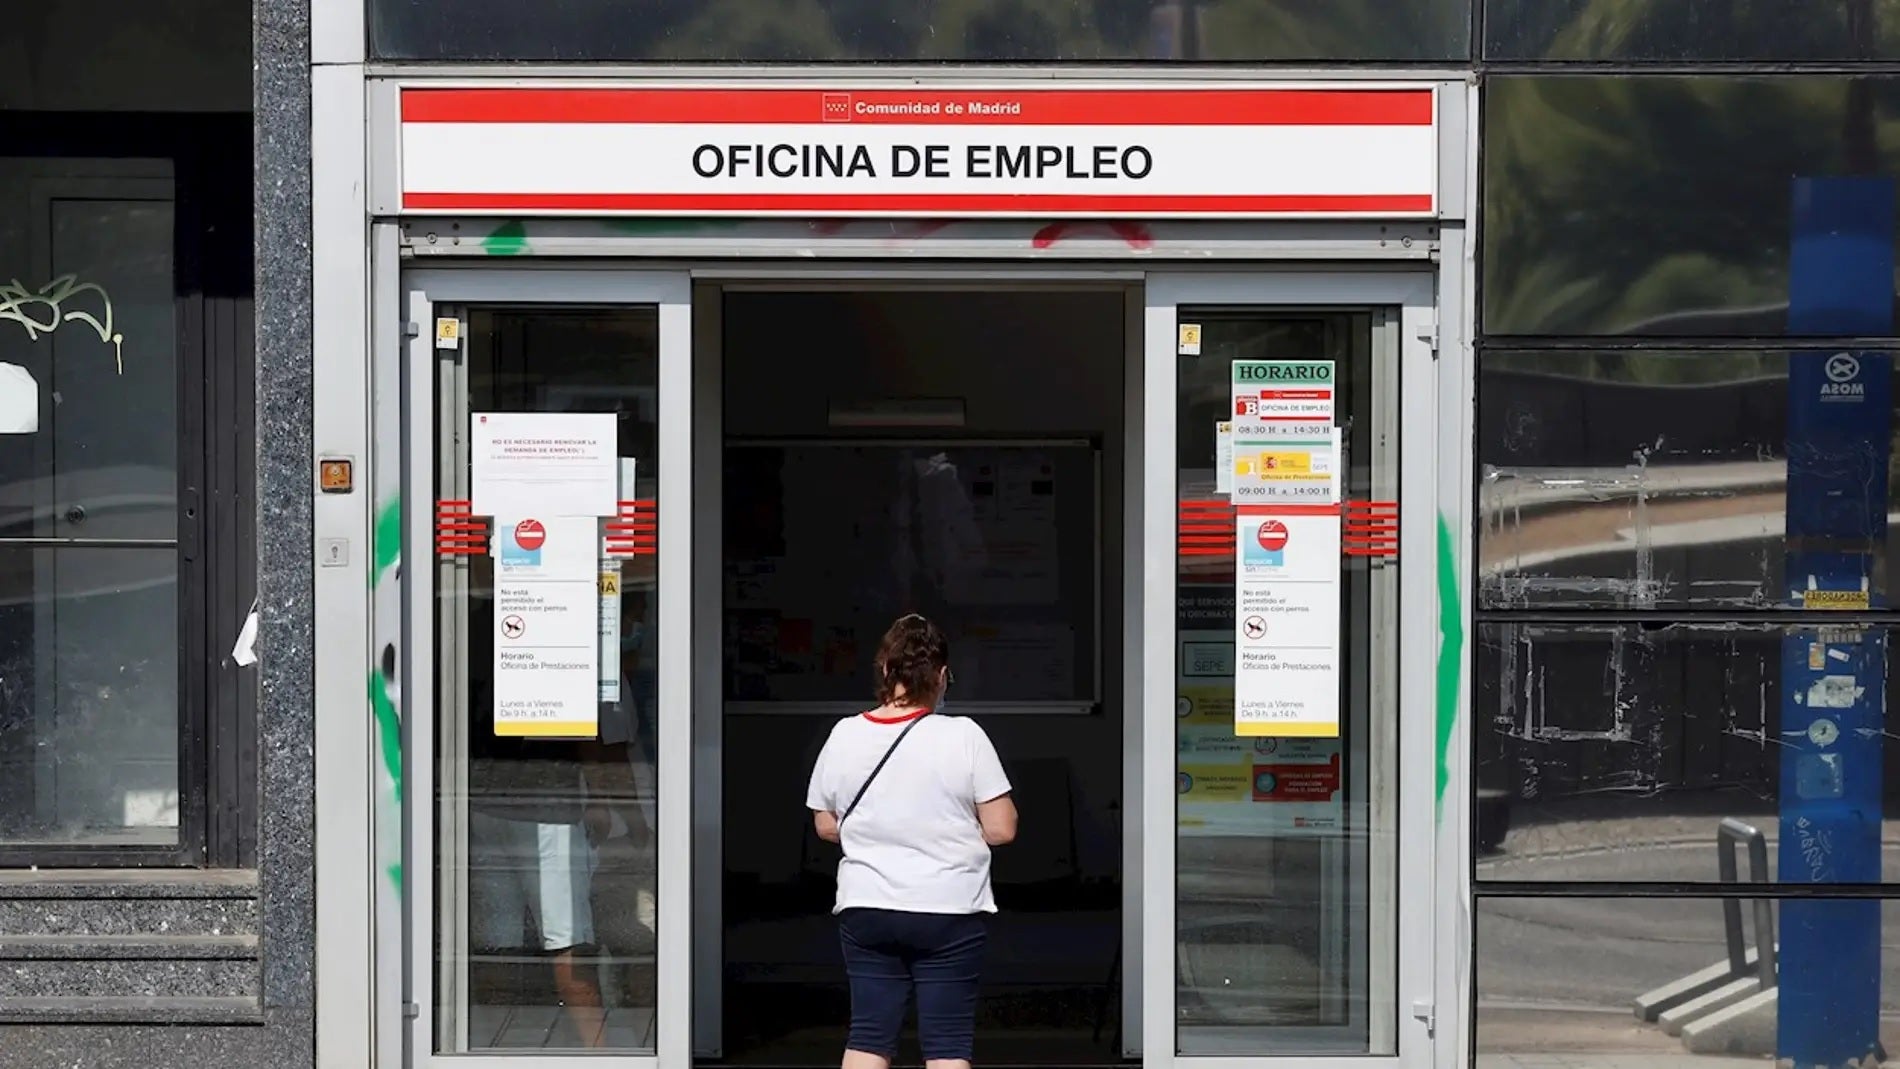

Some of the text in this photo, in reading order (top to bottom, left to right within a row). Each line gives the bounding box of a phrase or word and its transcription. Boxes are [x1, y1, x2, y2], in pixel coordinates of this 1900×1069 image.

[855, 101, 1021, 115] Comunidad de Madrid
[691, 144, 1153, 179] OFICINA DE EMPLEO
[1239, 365, 1329, 379] HORARIO
[1238, 426, 1265, 434] 08:30
[1267, 426, 1276, 434] H
[1294, 426, 1320, 434] 14:30
[1322, 426, 1330, 434] H
[1238, 487, 1265, 495] 09:00
[1267, 487, 1276, 495] H
[1294, 487, 1320, 495] 14:00
[1322, 487, 1330, 495] H
[501, 652, 534, 660] Horario
[1242, 652, 1276, 660] Horario
[501, 662, 590, 670] Oficina de Prestaciones
[1193, 660, 1226, 672] SEPE
[1282, 662, 1332, 671] Prestaciones
[1241, 700, 1266, 708] Lunes
[1275, 700, 1304, 708] Viernes
